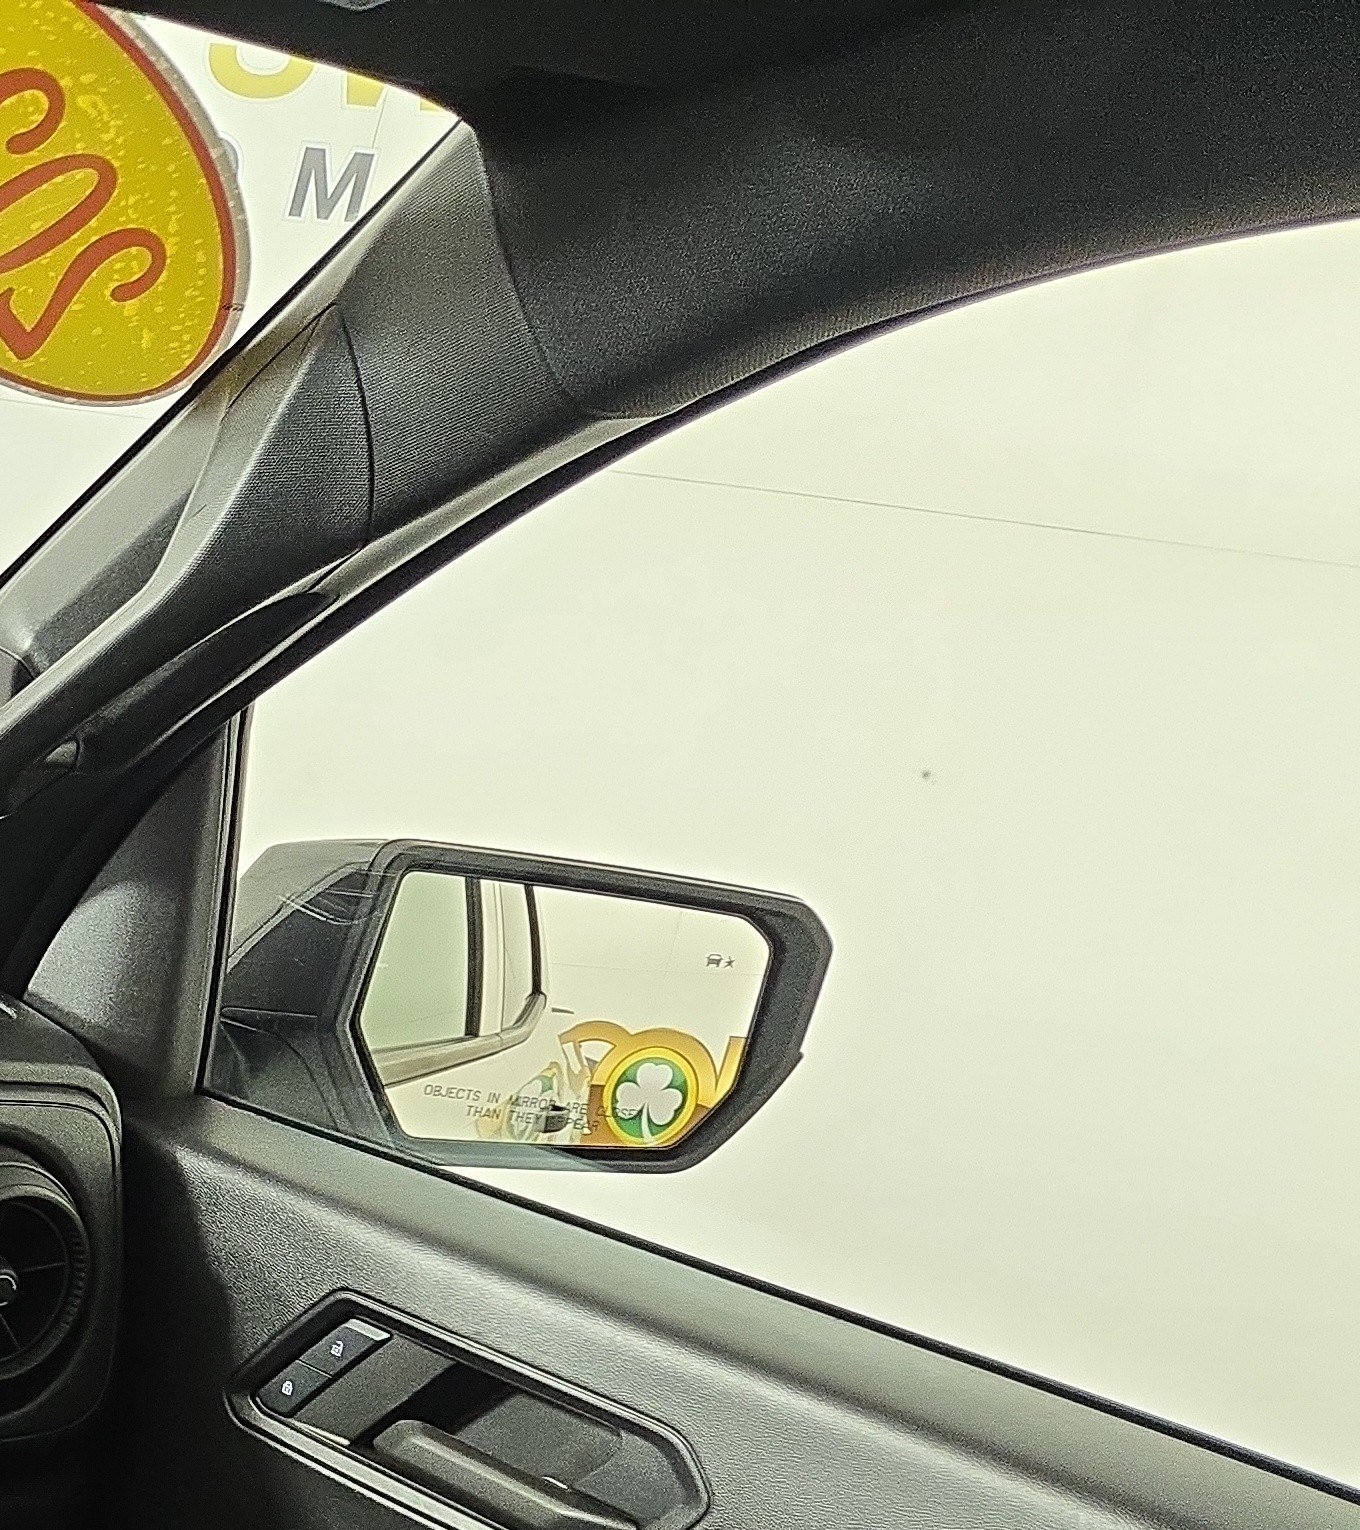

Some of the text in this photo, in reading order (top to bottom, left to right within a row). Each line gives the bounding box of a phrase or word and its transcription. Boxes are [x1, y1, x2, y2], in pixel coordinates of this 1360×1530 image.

[423, 1083, 482, 1102] OBJECTS
[488, 1091, 502, 1104] IN
[565, 1101, 588, 1115] ARE
[466, 1105, 502, 1120] THAN
[510, 1109, 543, 1125] THEY
